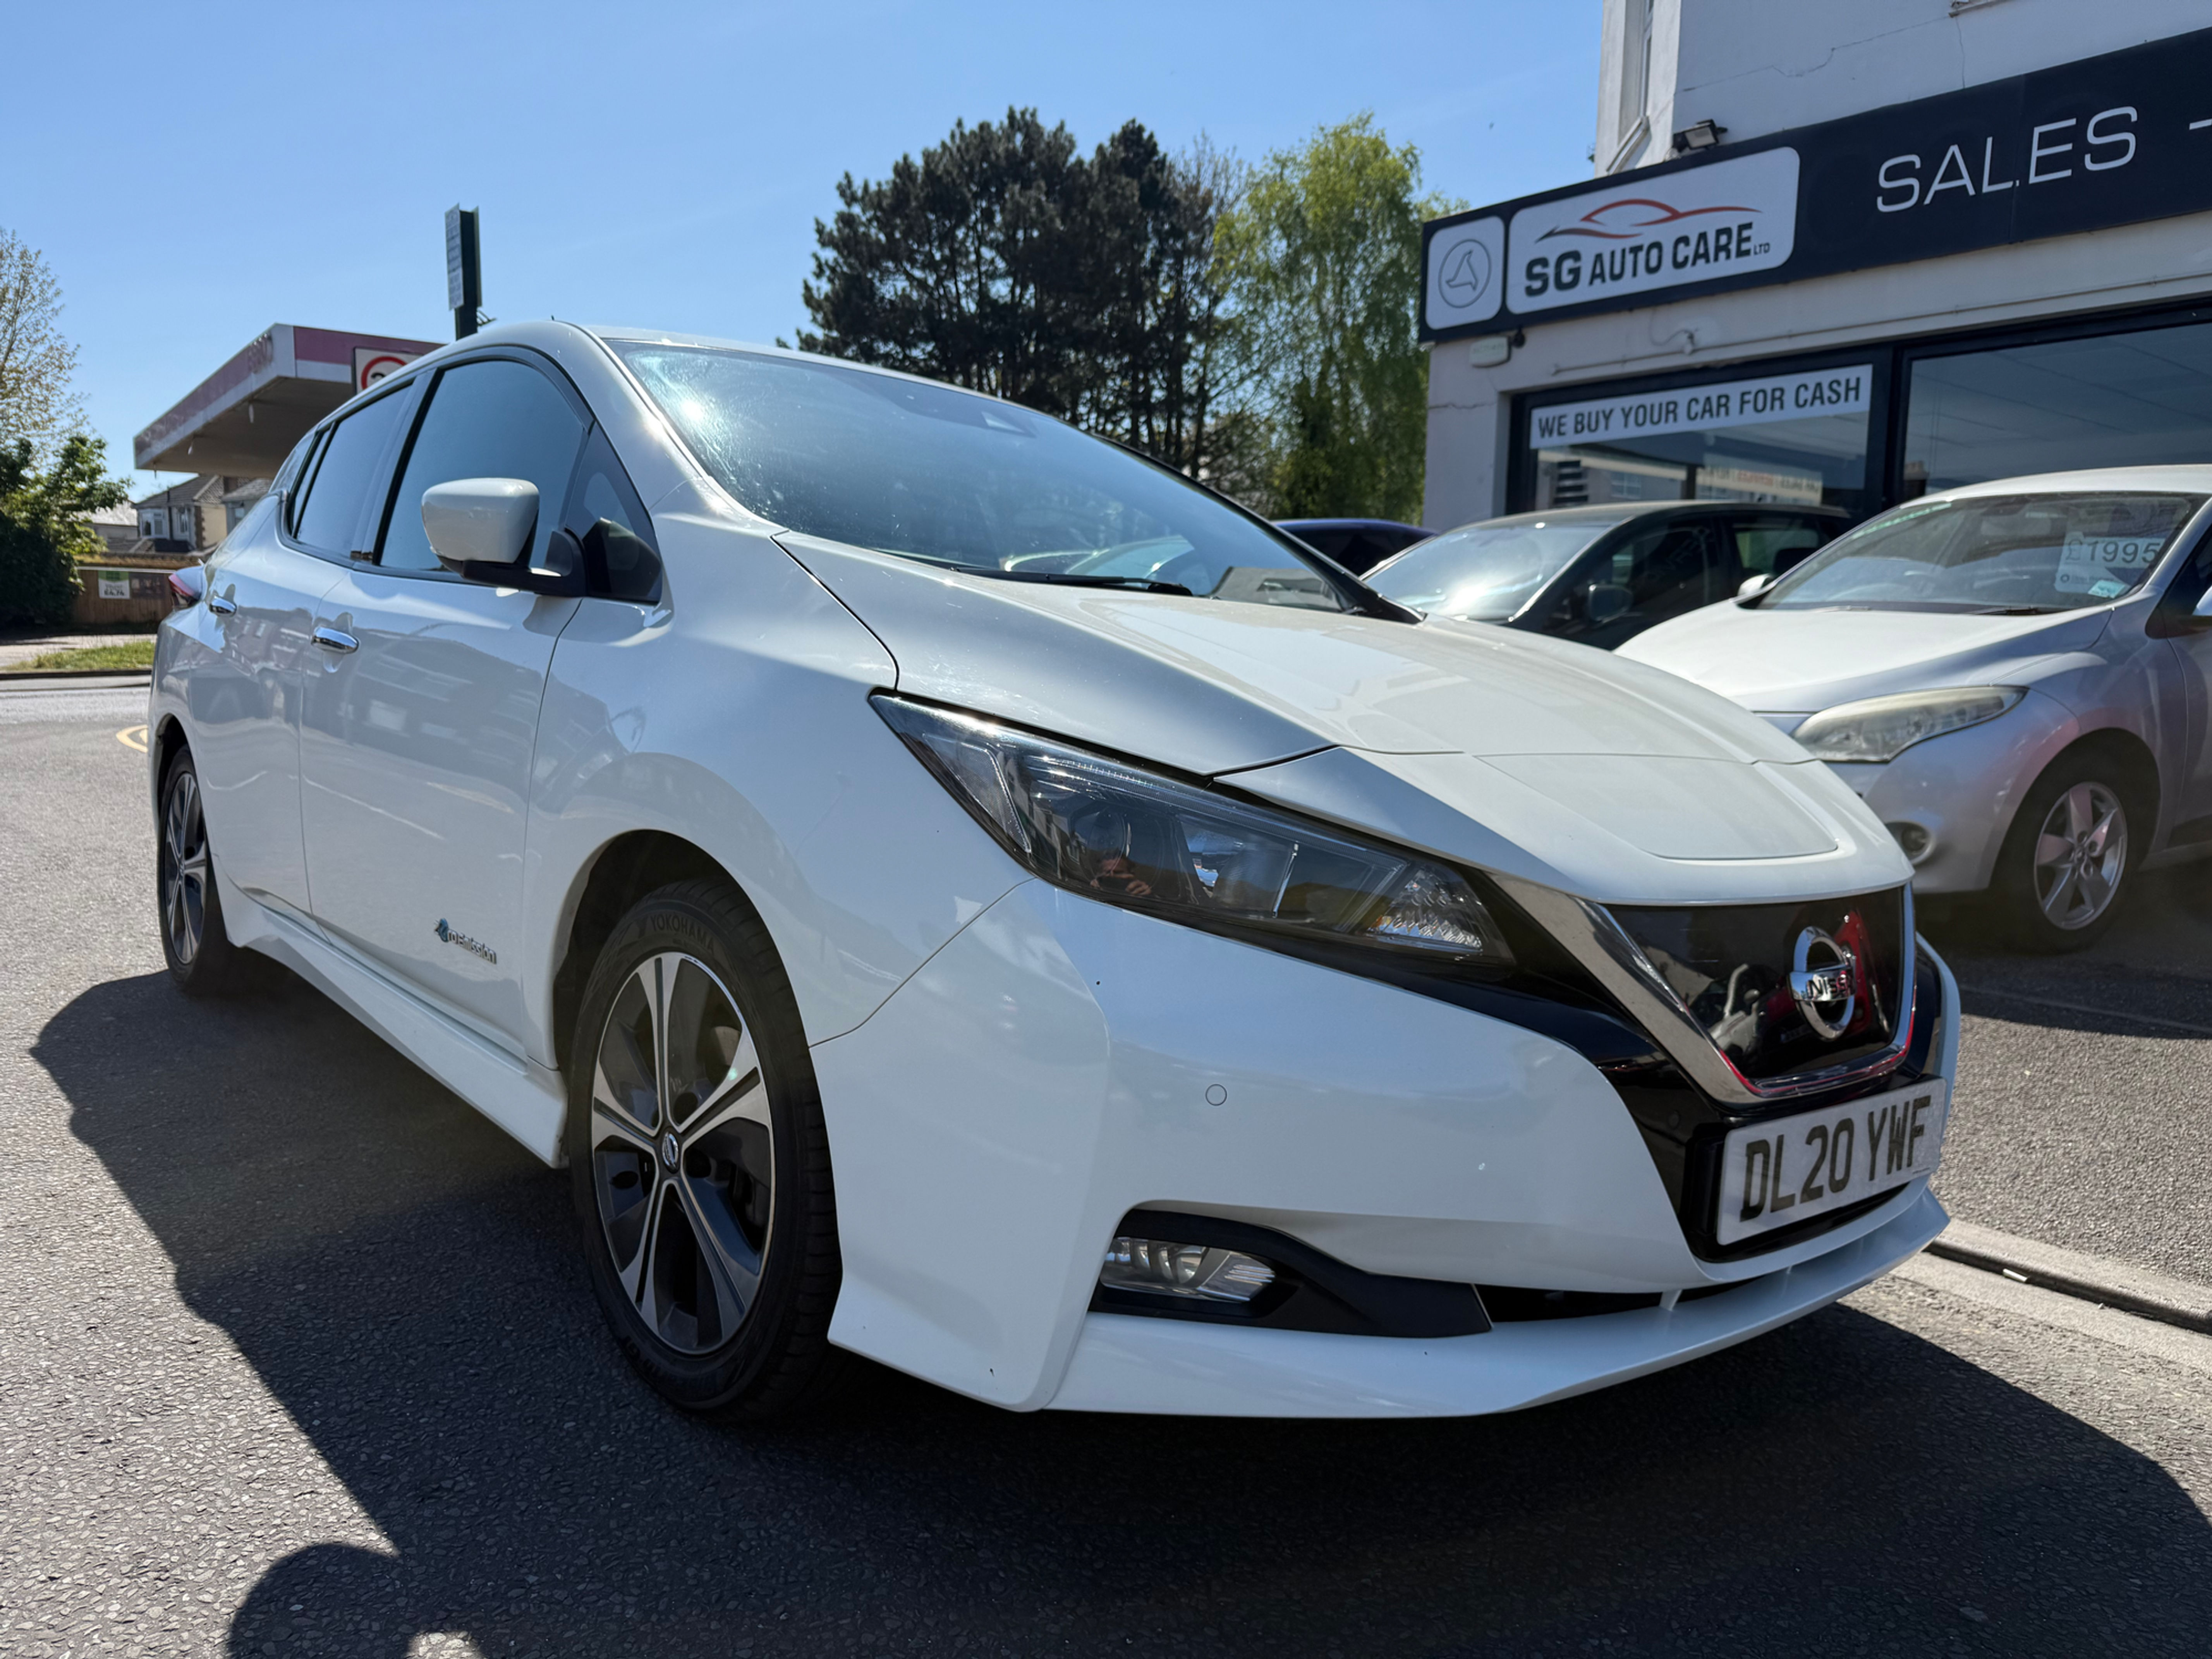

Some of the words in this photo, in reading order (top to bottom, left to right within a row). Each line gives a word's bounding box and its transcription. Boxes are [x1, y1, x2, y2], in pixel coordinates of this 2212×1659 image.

[1877, 106, 2138, 213] SALES
[1525, 250, 1582, 297] SG
[1589, 241, 1662, 286] AUTO
[1672, 222, 1753, 270] CARE
[1754, 243, 1770, 255] LTD
[1538, 414, 1567, 439] WE
[1574, 409, 1614, 433] BUY
[1621, 401, 1678, 428] YOUR
[1687, 394, 1730, 421] CAR
[1739, 387, 1785, 415] FOR
[1795, 377, 1861, 409] CASH
[650, 912, 714, 951] YOKOHAMA
[1740, 1118, 1854, 1221] DL20
[1868, 1095, 1931, 1181] YWF
